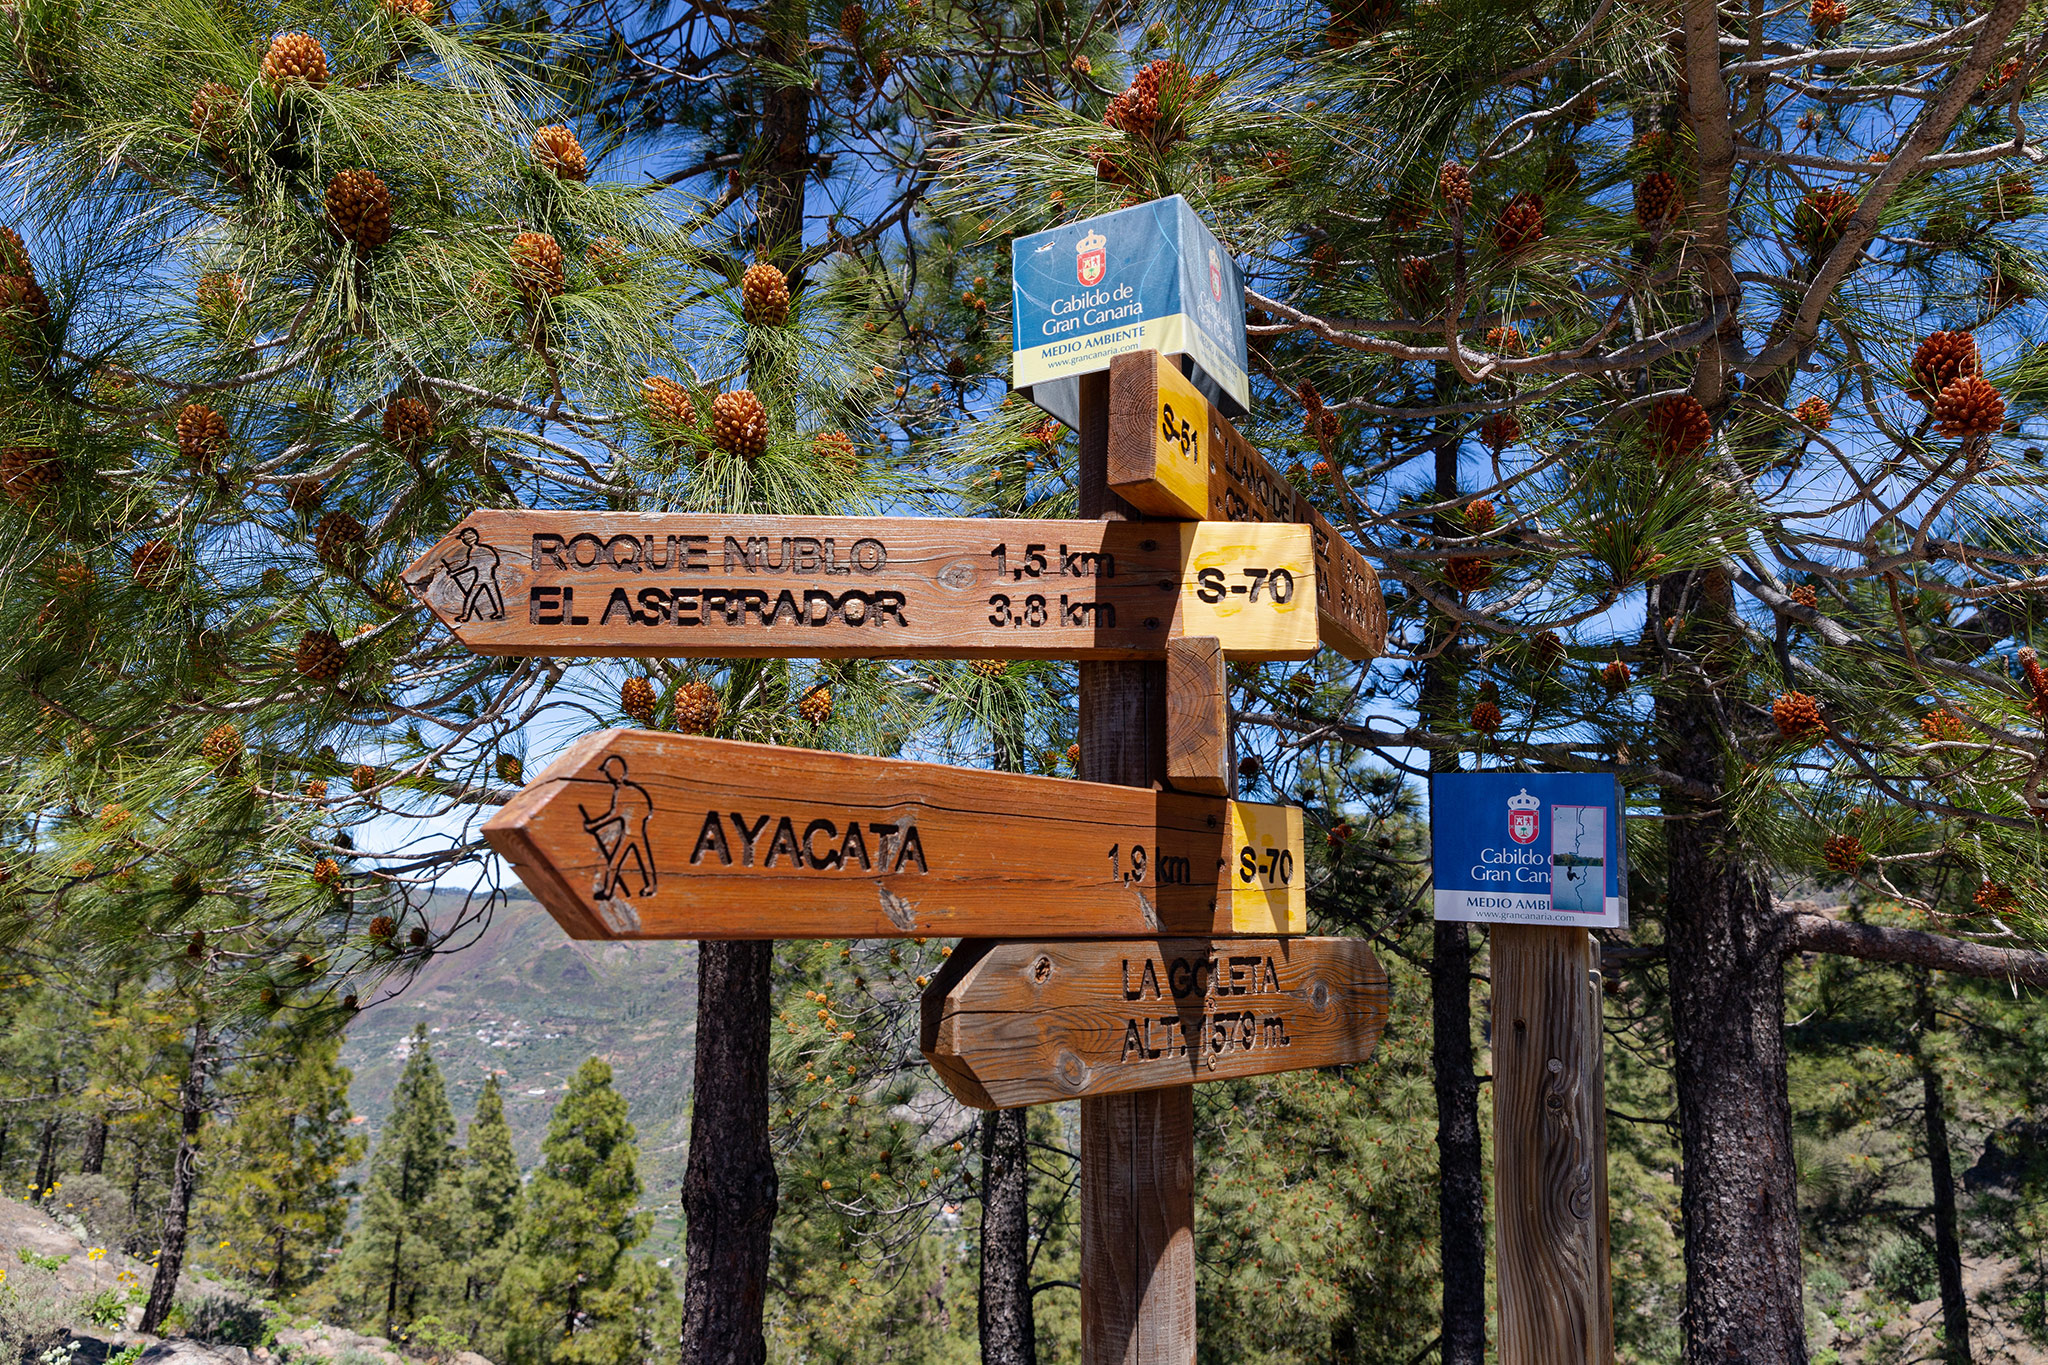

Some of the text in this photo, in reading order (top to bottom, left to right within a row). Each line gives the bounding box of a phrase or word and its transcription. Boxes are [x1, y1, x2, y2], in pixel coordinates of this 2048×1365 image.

[1042, 301, 1143, 336] Gran Canaria
[1051, 285, 1133, 316] Cabildo de
[1041, 325, 1146, 360] MEDIO AMBIENTE
[1047, 342, 1139, 369] www.grancanaria.com
[1162, 402, 1199, 465] S-51
[531, 533, 1116, 582] ROQUE NUBLO 1,5 km
[1196, 567, 1294, 605] S-70
[529, 586, 589, 627] EL
[600, 587, 909, 628] ASERRADOR
[1059, 593, 1117, 629] km
[689, 810, 1191, 889] AYACATA 1,9 km
[1239, 845, 1294, 885] S-70
[1480, 848, 1544, 866] Cabildo
[1470, 865, 1511, 882] Gran
[1466, 896, 1551, 911] MEDIO AMBI
[1475, 910, 1575, 922] www.grancanaria.com
[1122, 956, 1281, 1001] LA GOLETA
[1199, 1010, 1257, 1056] 1579
[1263, 1016, 1291, 1050] m.
